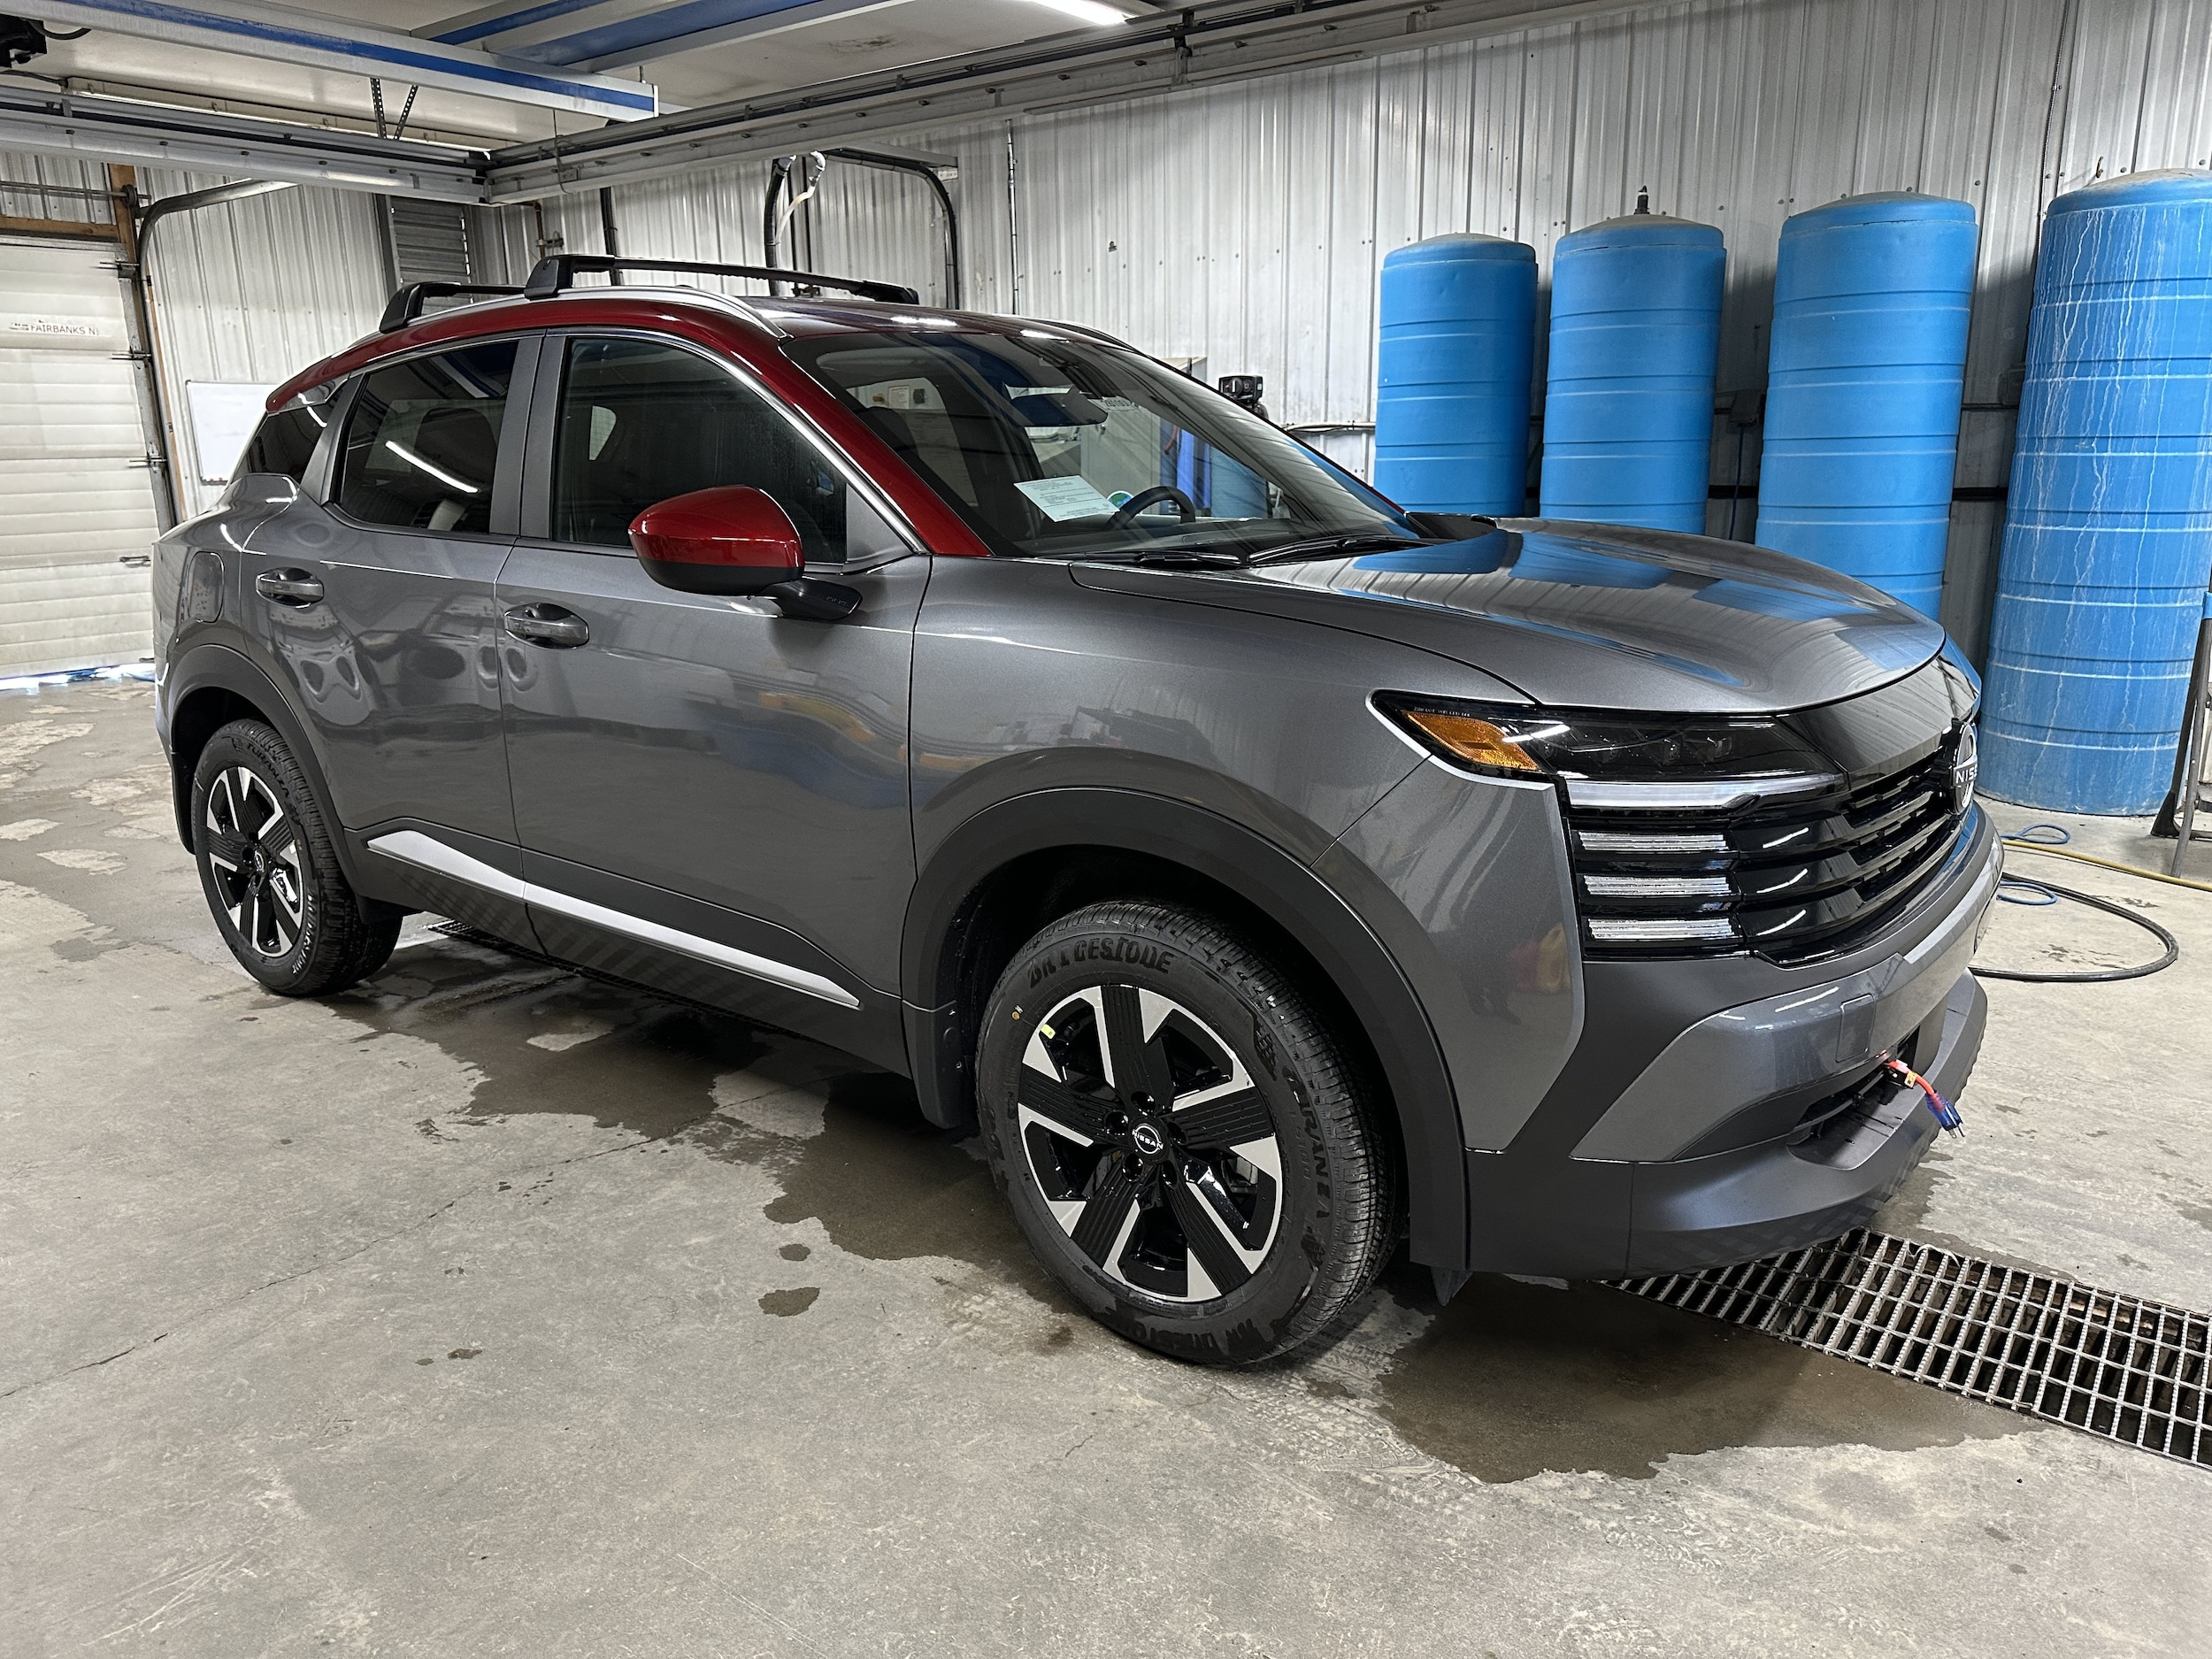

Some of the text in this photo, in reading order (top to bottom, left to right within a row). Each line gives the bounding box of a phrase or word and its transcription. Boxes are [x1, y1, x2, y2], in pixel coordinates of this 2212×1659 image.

[30, 324, 86, 334] FAIRBANKS
[1028, 935, 1175, 989] BRDGESTONE
[1131, 1128, 1164, 1150] NISSAN
